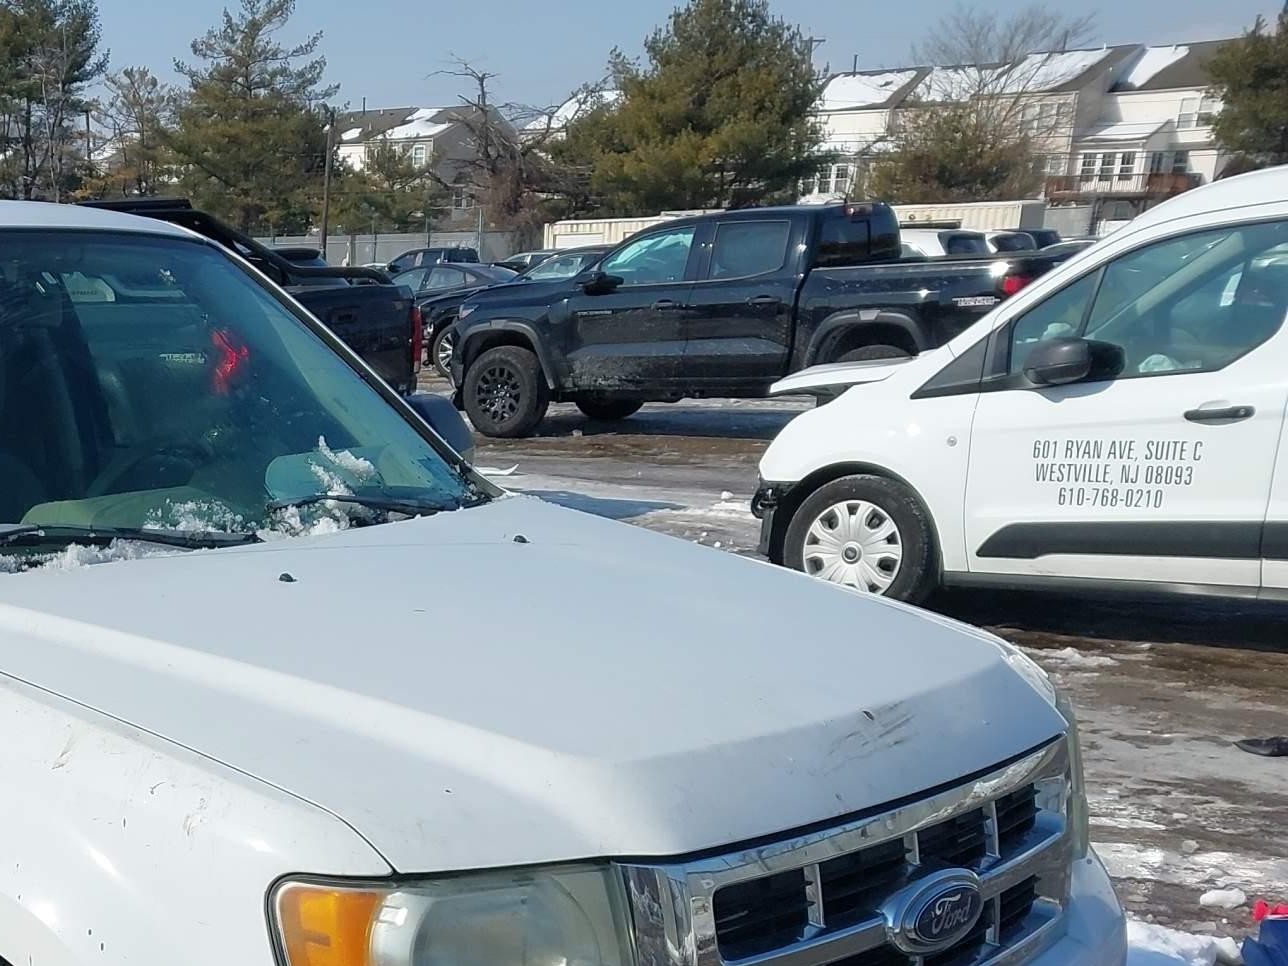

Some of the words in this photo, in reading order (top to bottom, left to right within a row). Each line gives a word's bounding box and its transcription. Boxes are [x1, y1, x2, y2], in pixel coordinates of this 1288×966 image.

[1032, 439, 1058, 459] 601
[1064, 439, 1103, 460] RYAN
[1107, 440, 1139, 462] AVE,
[1144, 440, 1188, 461] SUITE
[1192, 441, 1204, 461] C
[1035, 463, 1114, 485] WESTVILLE,
[1120, 464, 1140, 484] NJ
[1144, 465, 1194, 485] 08093
[1058, 487, 1164, 508] 610-768-0210
[931, 892, 972, 935] Ford
